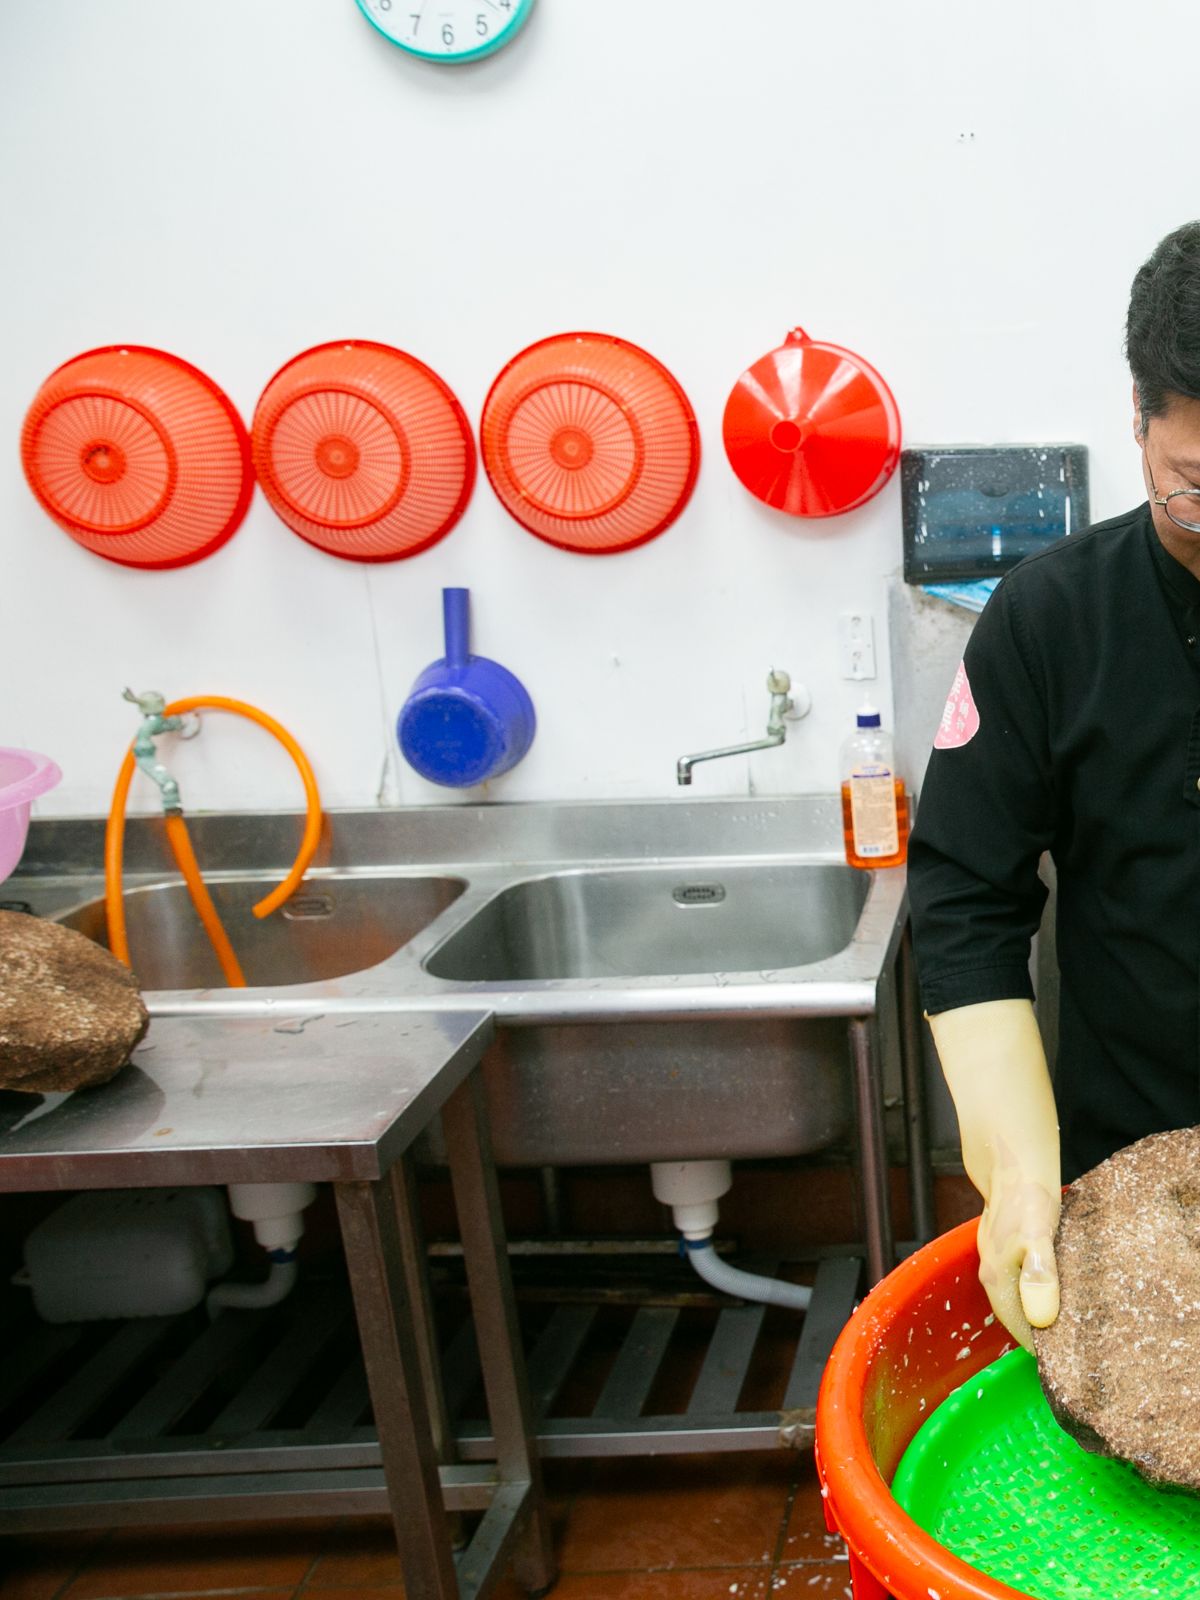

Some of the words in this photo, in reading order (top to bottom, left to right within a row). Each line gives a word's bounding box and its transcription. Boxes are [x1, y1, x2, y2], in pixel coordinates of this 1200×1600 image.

[410, 14, 421, 36] 7
[441, 23, 455, 46] 6
[476, 14, 488, 36] 5
